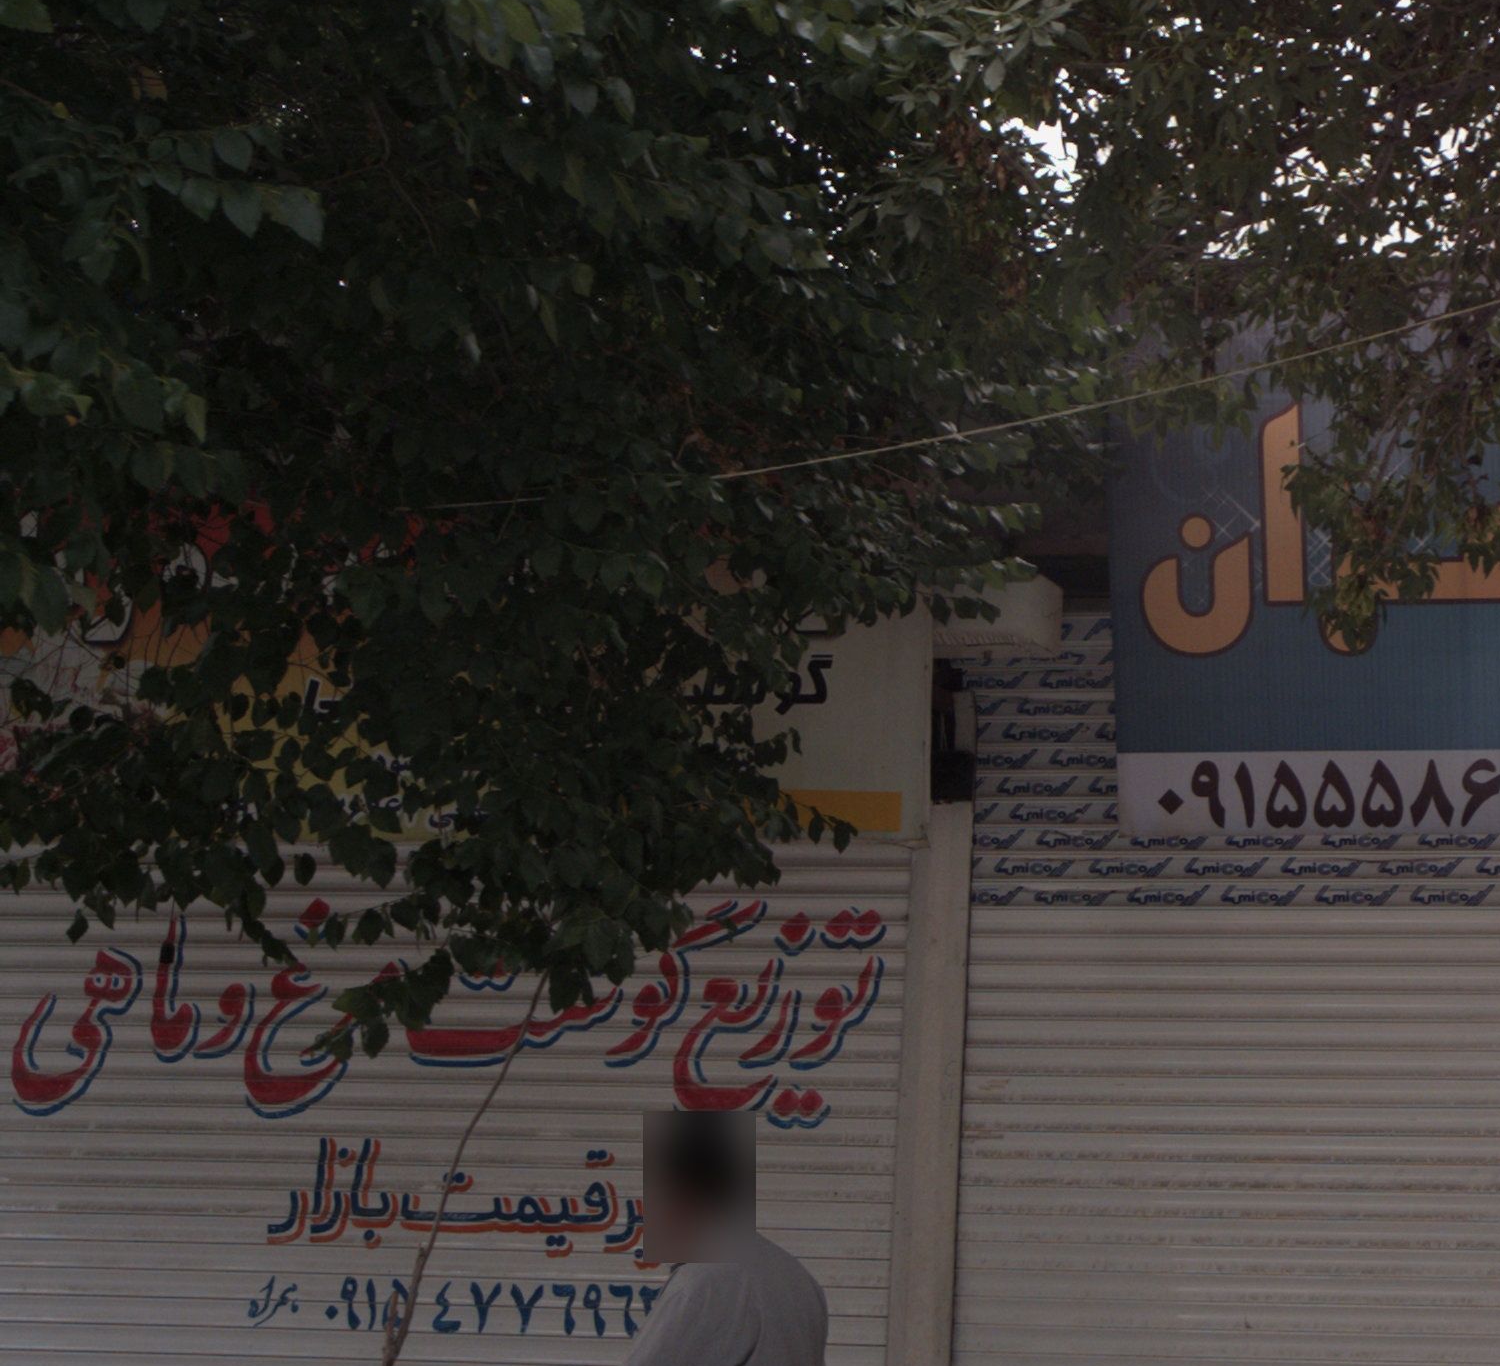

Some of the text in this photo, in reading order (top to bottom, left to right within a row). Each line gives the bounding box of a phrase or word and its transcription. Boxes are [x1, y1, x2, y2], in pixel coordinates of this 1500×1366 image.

[11, 915, 200, 1117] ماهی
[672, 906, 888, 1129] توزیع
[267, 1138, 398, 1250] بازار
[400, 1149, 619, 1257] قیمت
